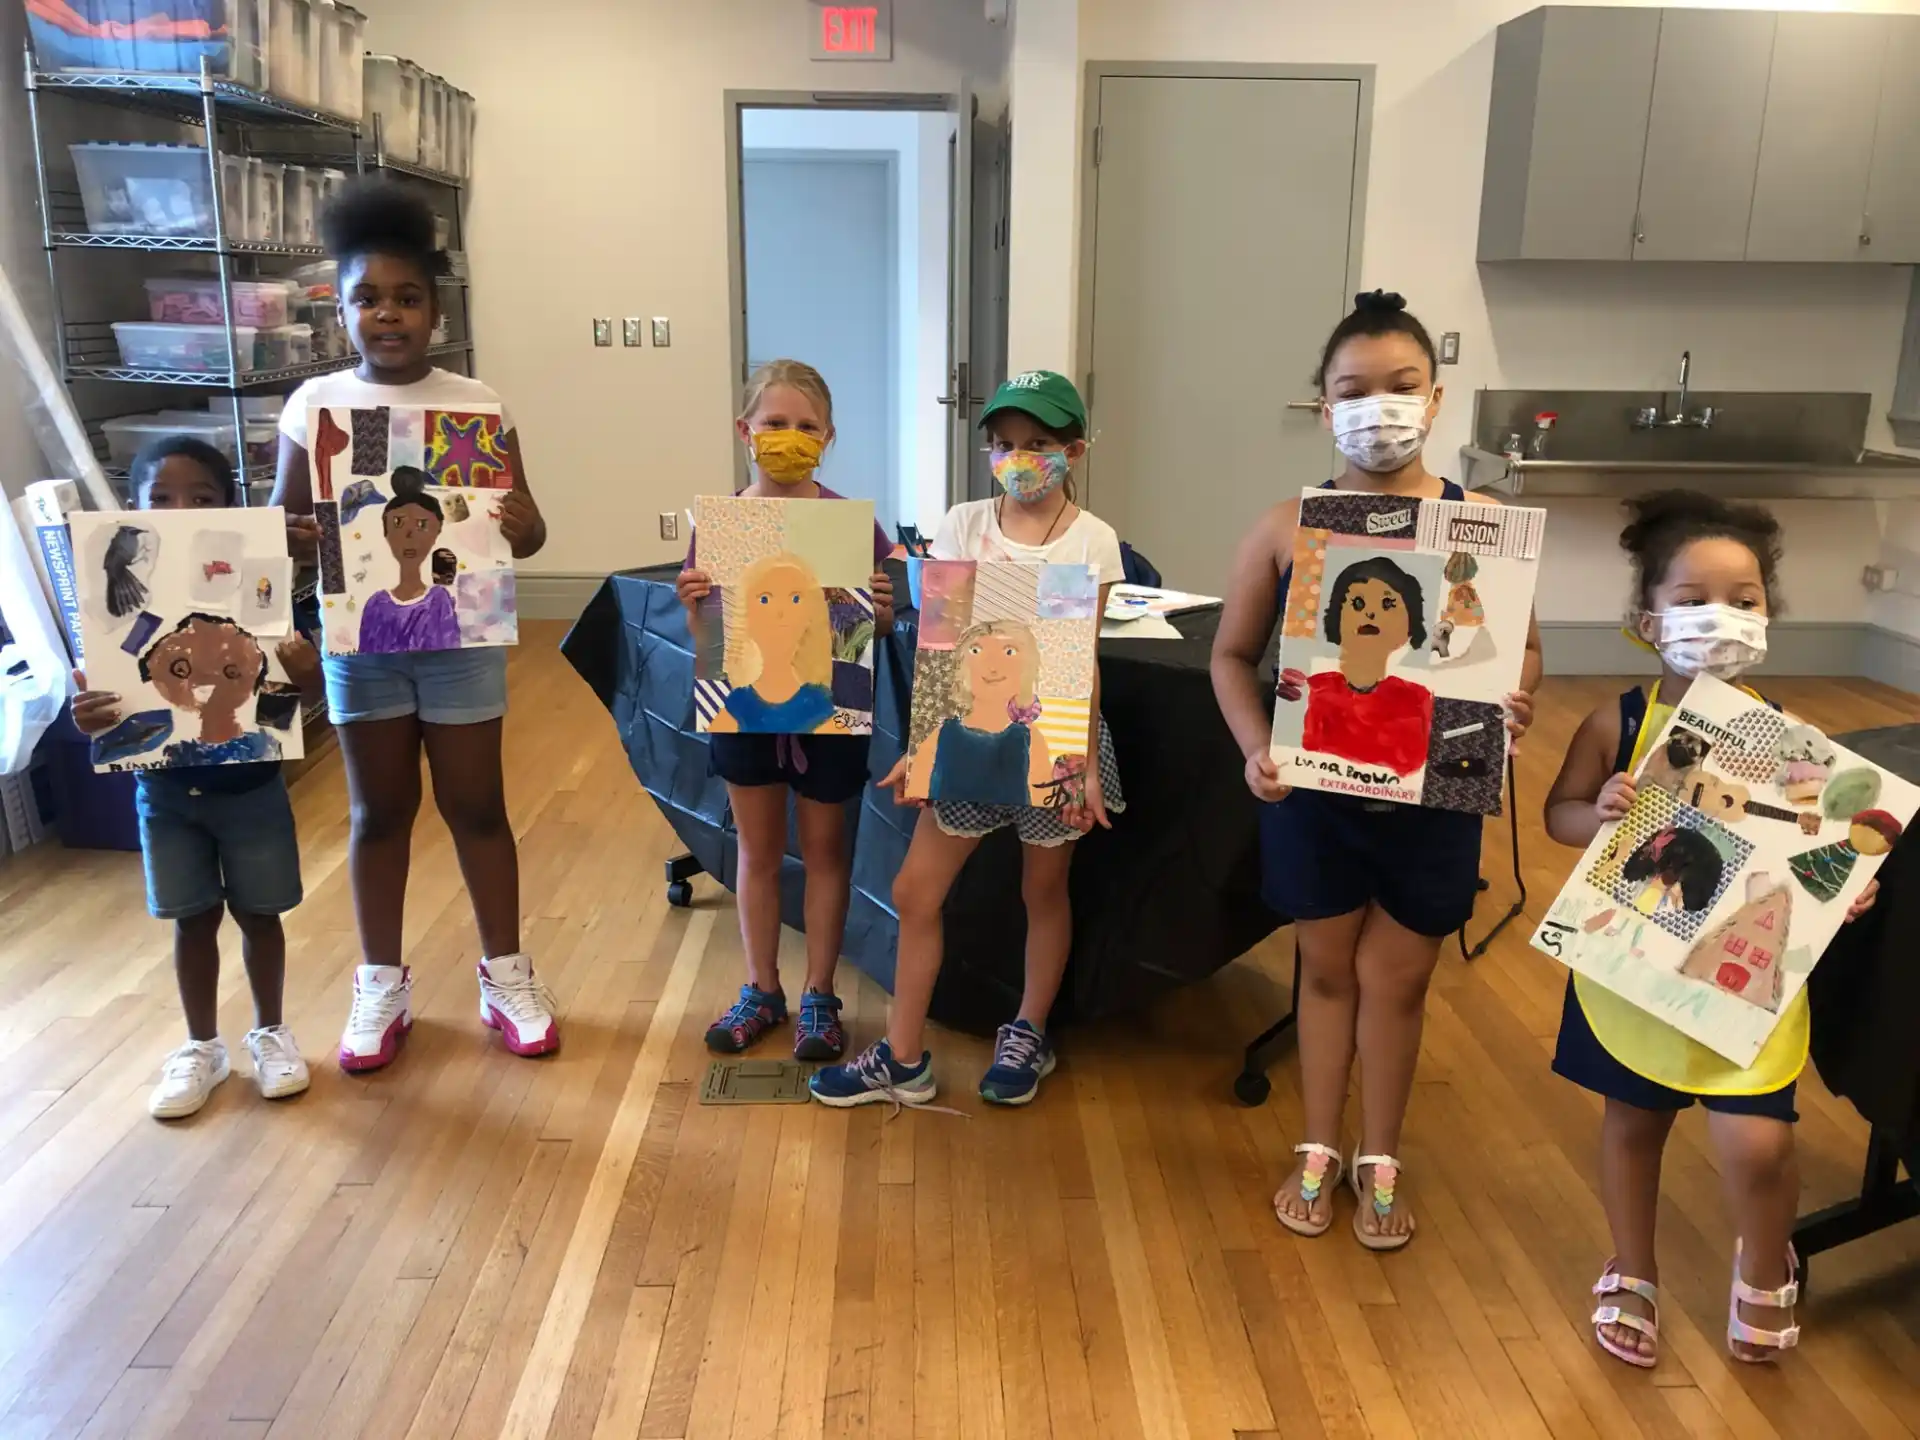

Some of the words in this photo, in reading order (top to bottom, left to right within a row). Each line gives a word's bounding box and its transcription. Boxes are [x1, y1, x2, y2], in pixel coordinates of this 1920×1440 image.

[823, 7, 877, 52] EXIT
[1368, 510, 1411, 531] Sweet
[1451, 521, 1499, 545] VISION
[43, 530, 77, 609] NEWSPRINT
[1678, 711, 1746, 751] BEAUTIFUL
[1320, 779, 1416, 800] EXTRAORDINARY
